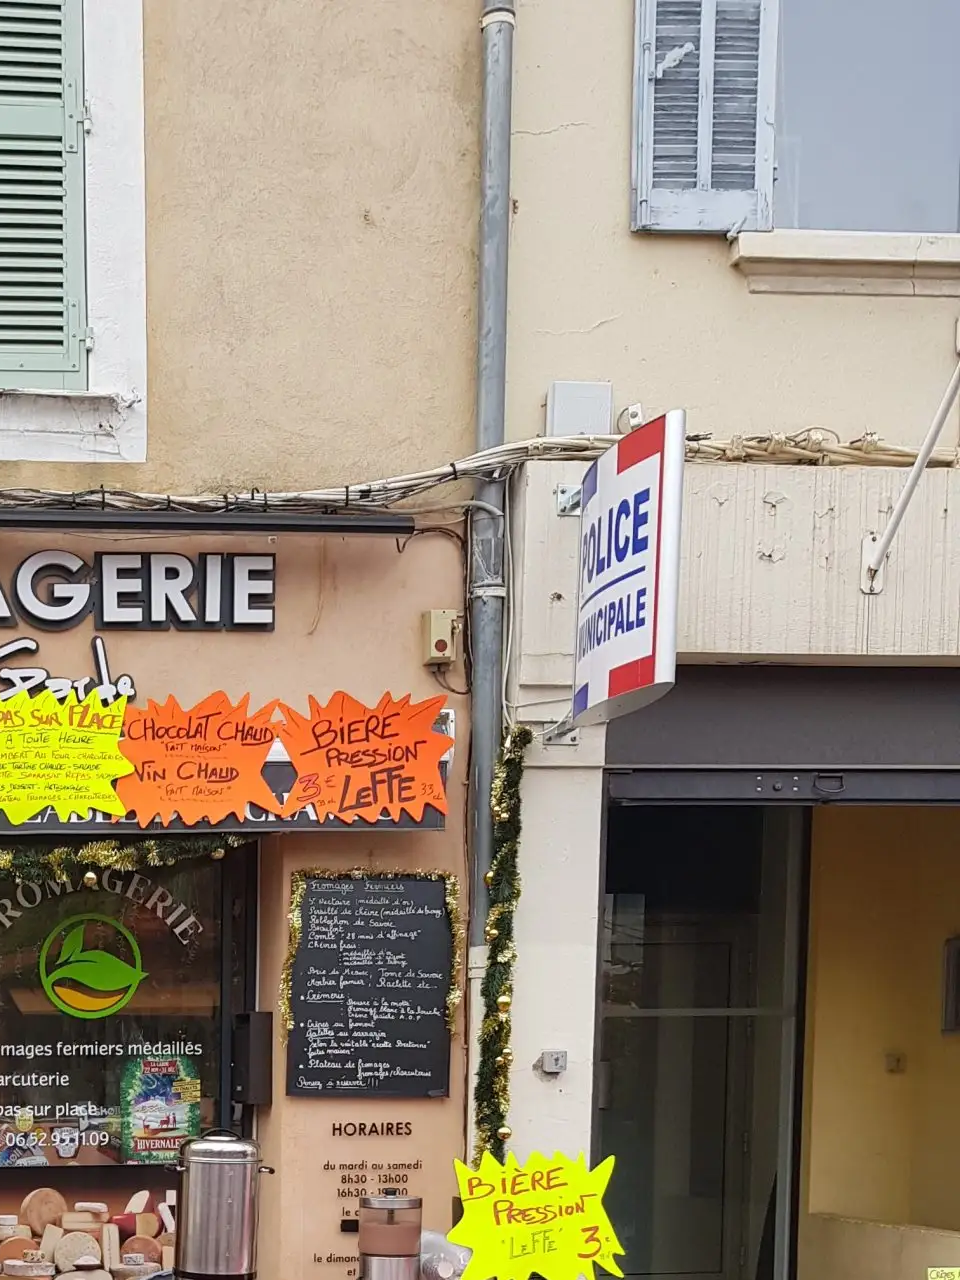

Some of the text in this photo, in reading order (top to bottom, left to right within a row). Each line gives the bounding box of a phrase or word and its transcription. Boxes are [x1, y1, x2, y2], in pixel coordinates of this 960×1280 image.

[581, 487, 650, 595] POLICE
[578, 587, 647, 662] MUNICIPALE
[29, 709, 62, 727] SUR
[68, 704, 122, 730] PLACE
[127, 712, 274, 746] CHOCOLAT CHAUD
[22, 733, 50, 744] TOUTE
[59, 732, 97, 745] HEURE
[325, 740, 427, 768] PRESSION
[134, 760, 239, 783] VIN CHAUD
[296, 773, 322, 801] 3
[338, 764, 417, 813] LEFFE
[56, 1041, 124, 1057] fermiers
[128, 1040, 203, 1057] médaillés
[25, 1105, 53, 1117] sur
[55, 1101, 98, 1119] place
[331, 1121, 413, 1137] HORAIRES
[323, 1159, 423, 1171] du mardi au samedi
[340, 1174, 367, 1184] 8h30
[378, 1173, 409, 1184] 13h00
[463, 1167, 568, 1202] BIÈRE
[336, 1188, 367, 1198] 16h30
[342, 1207, 352, 1217] le
[493, 1194, 597, 1226] PRESSION
[577, 1225, 602, 1259] 3
[313, 1253, 323, 1263] le
